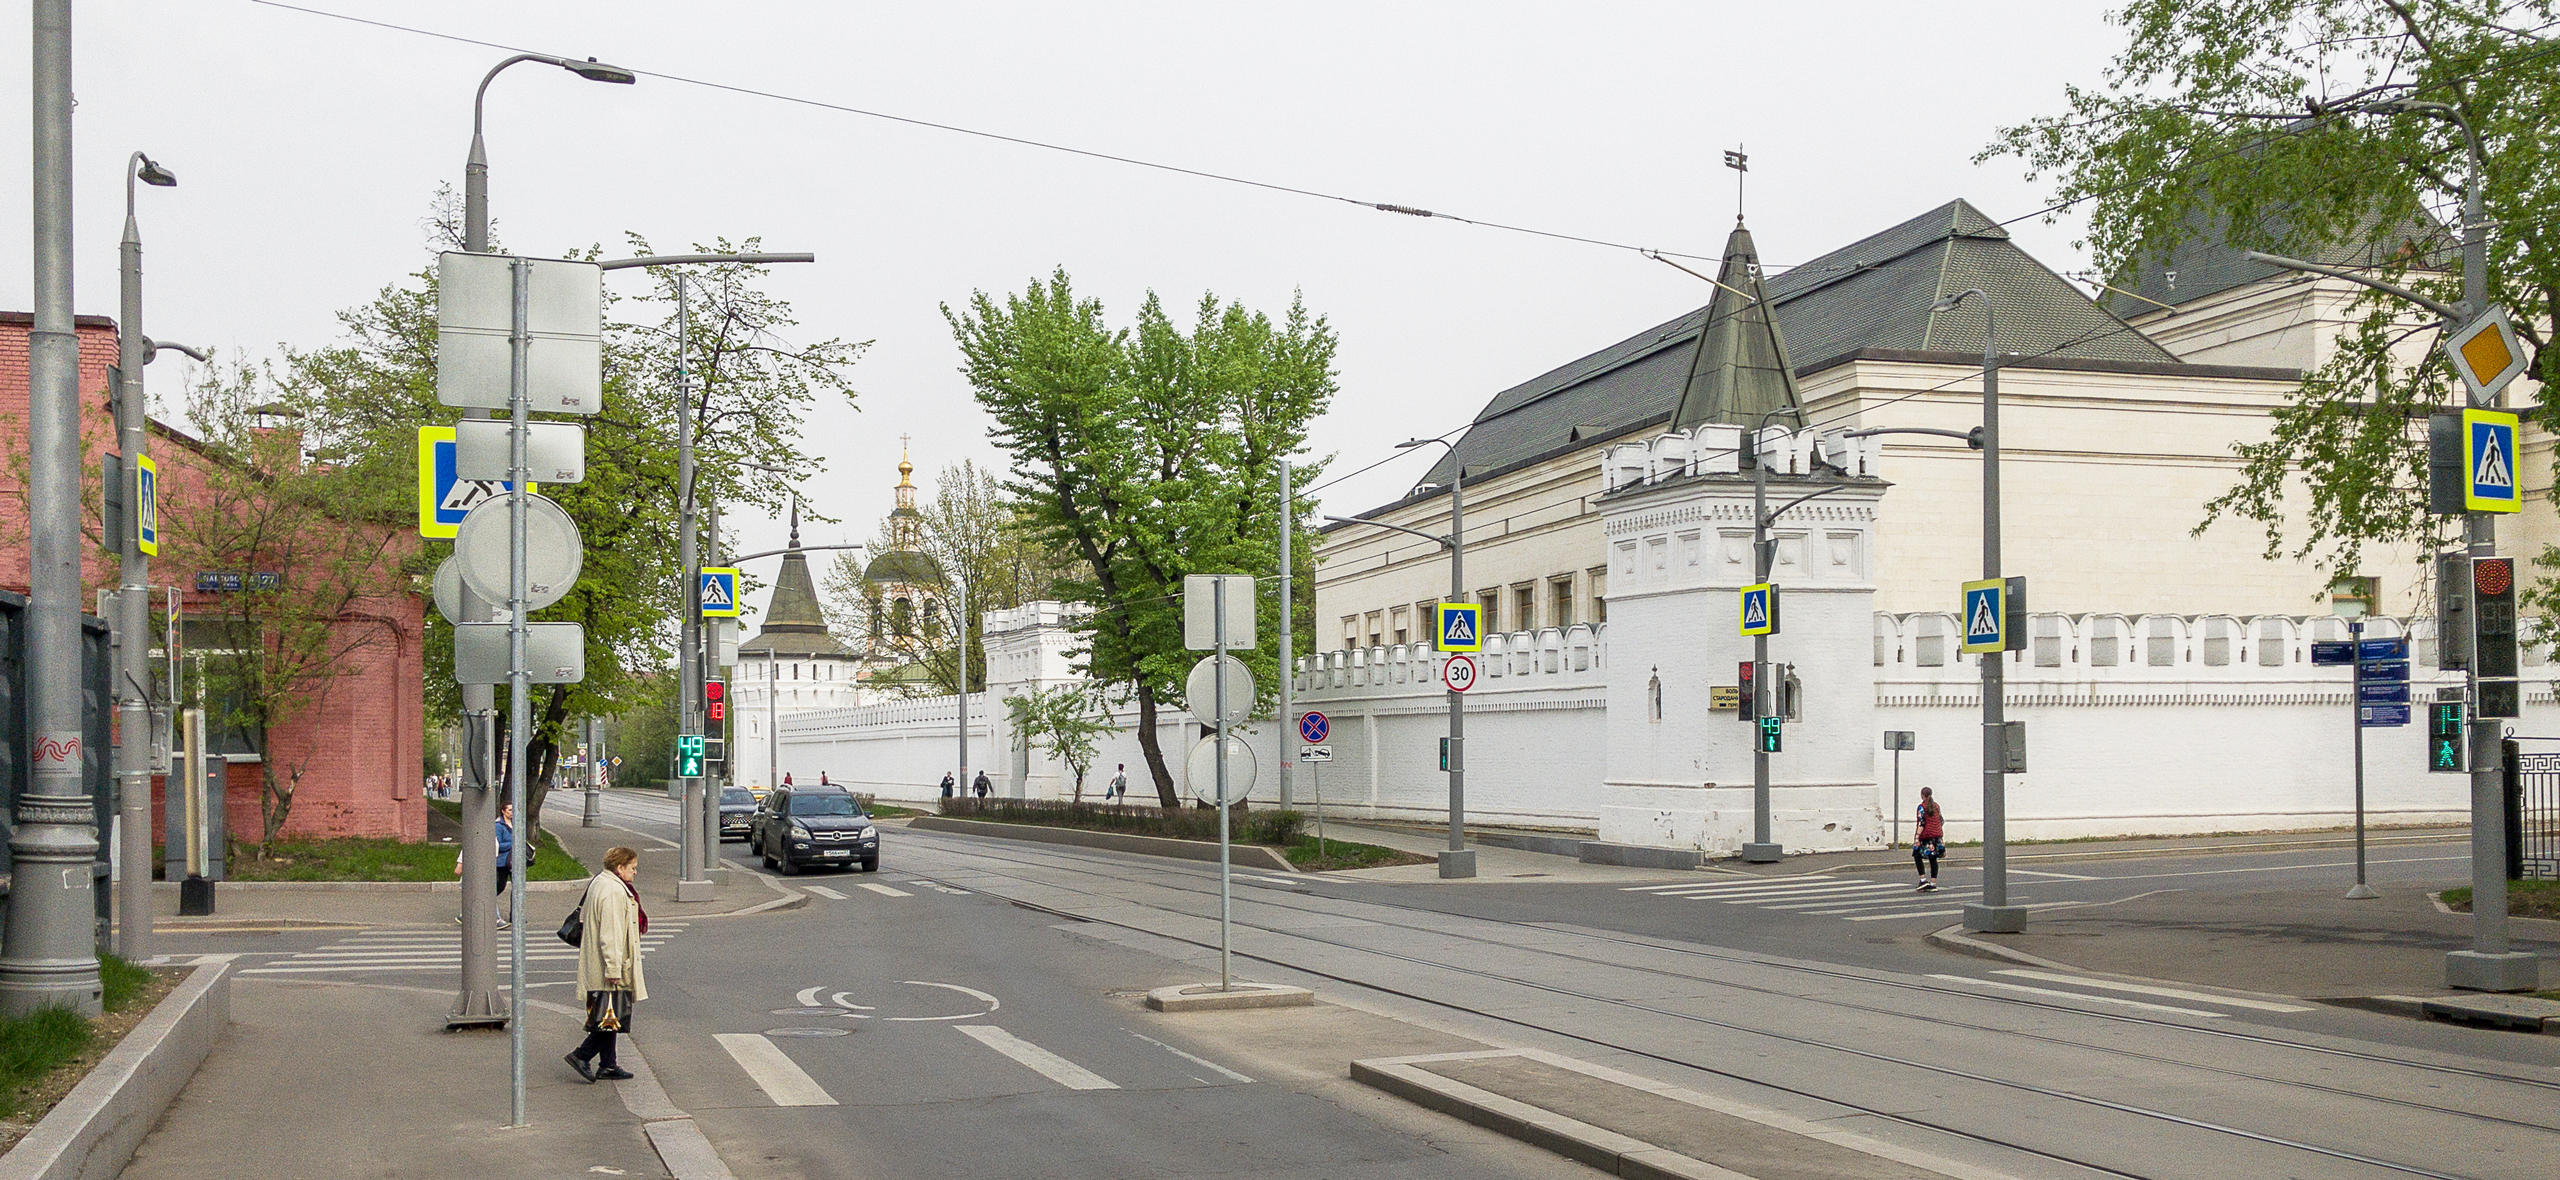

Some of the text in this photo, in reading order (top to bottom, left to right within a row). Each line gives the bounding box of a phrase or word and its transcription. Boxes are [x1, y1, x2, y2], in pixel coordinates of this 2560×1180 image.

[261, 575, 275, 585] 27
[1451, 666, 1469, 681] 30
[711, 702, 724, 719] 18
[1762, 717, 1780, 734] 49
[2442, 705, 2462, 734] 14
[680, 736, 703, 757] 49
